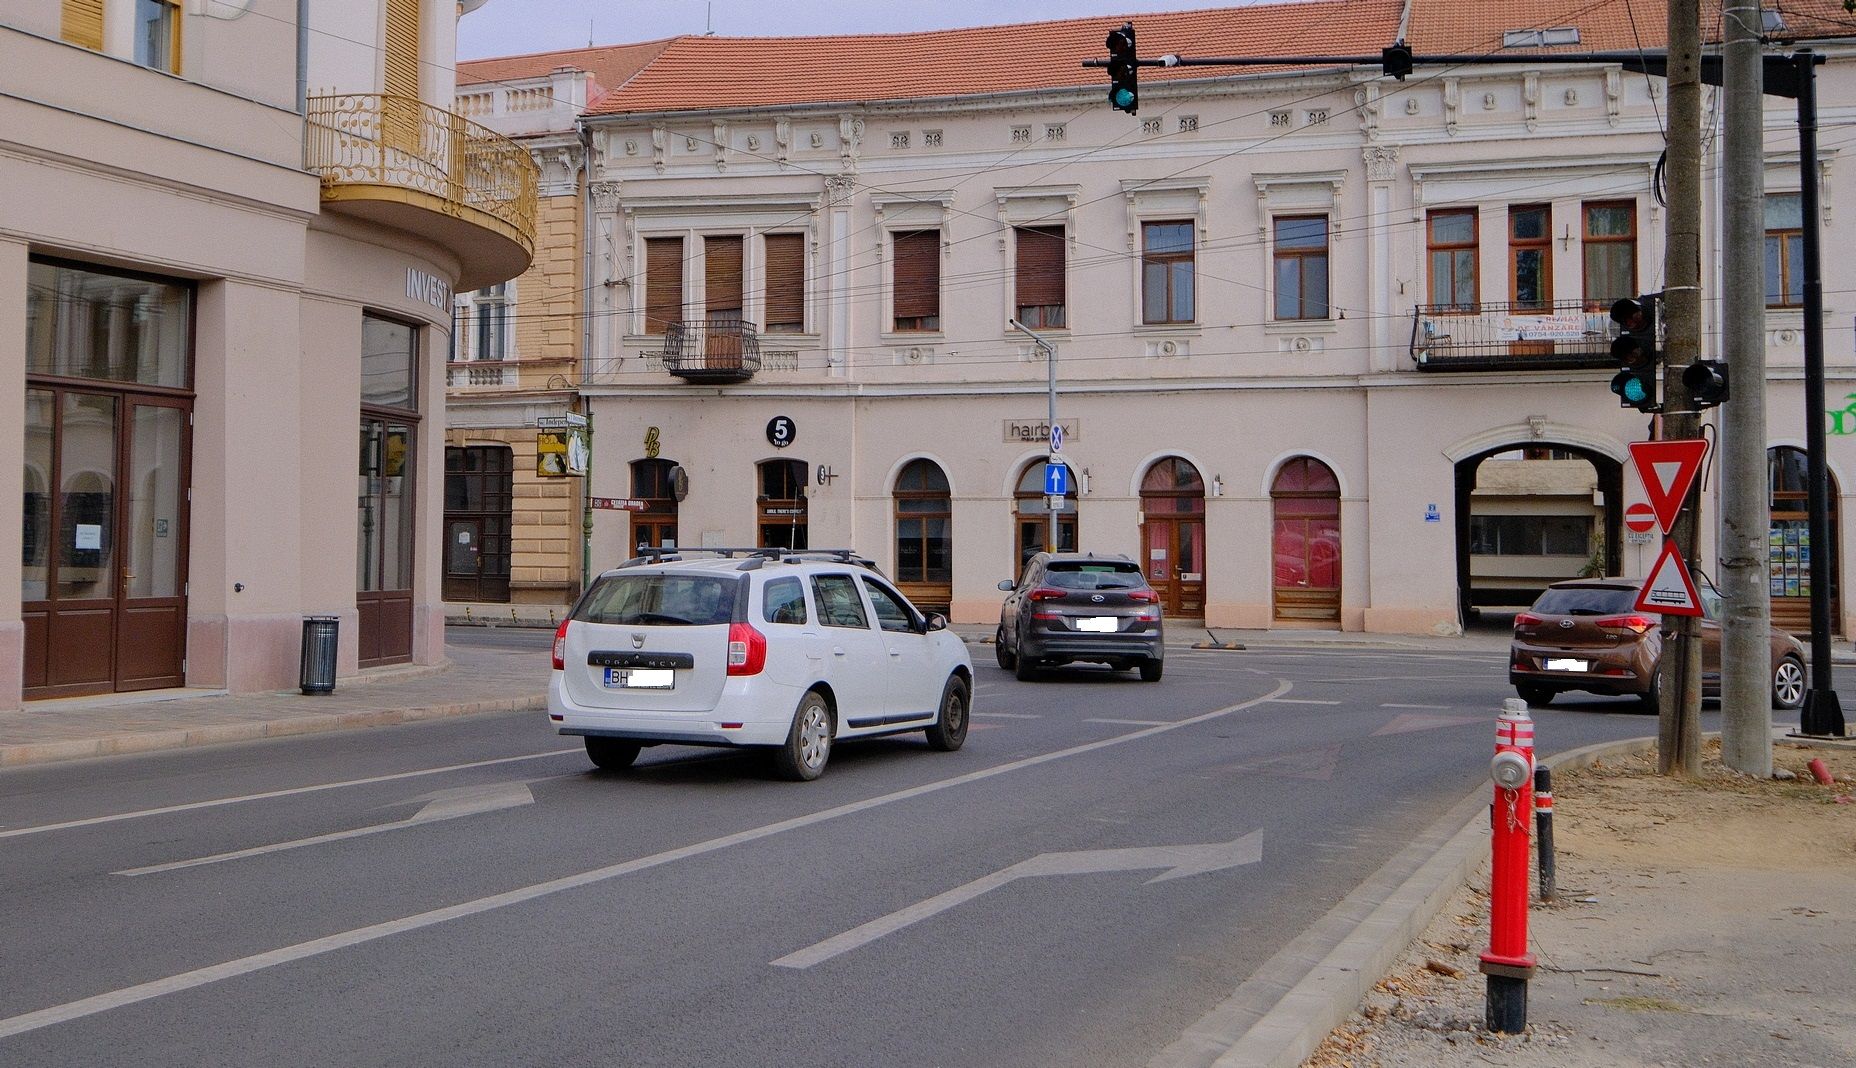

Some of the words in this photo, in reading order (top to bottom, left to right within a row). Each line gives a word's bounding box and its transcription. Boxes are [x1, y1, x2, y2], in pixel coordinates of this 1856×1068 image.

[406, 267, 453, 313] INVEST
[774, 419, 788, 440] 5
[1010, 421, 1070, 437] hairbx
[611, 671, 628, 683] BH
